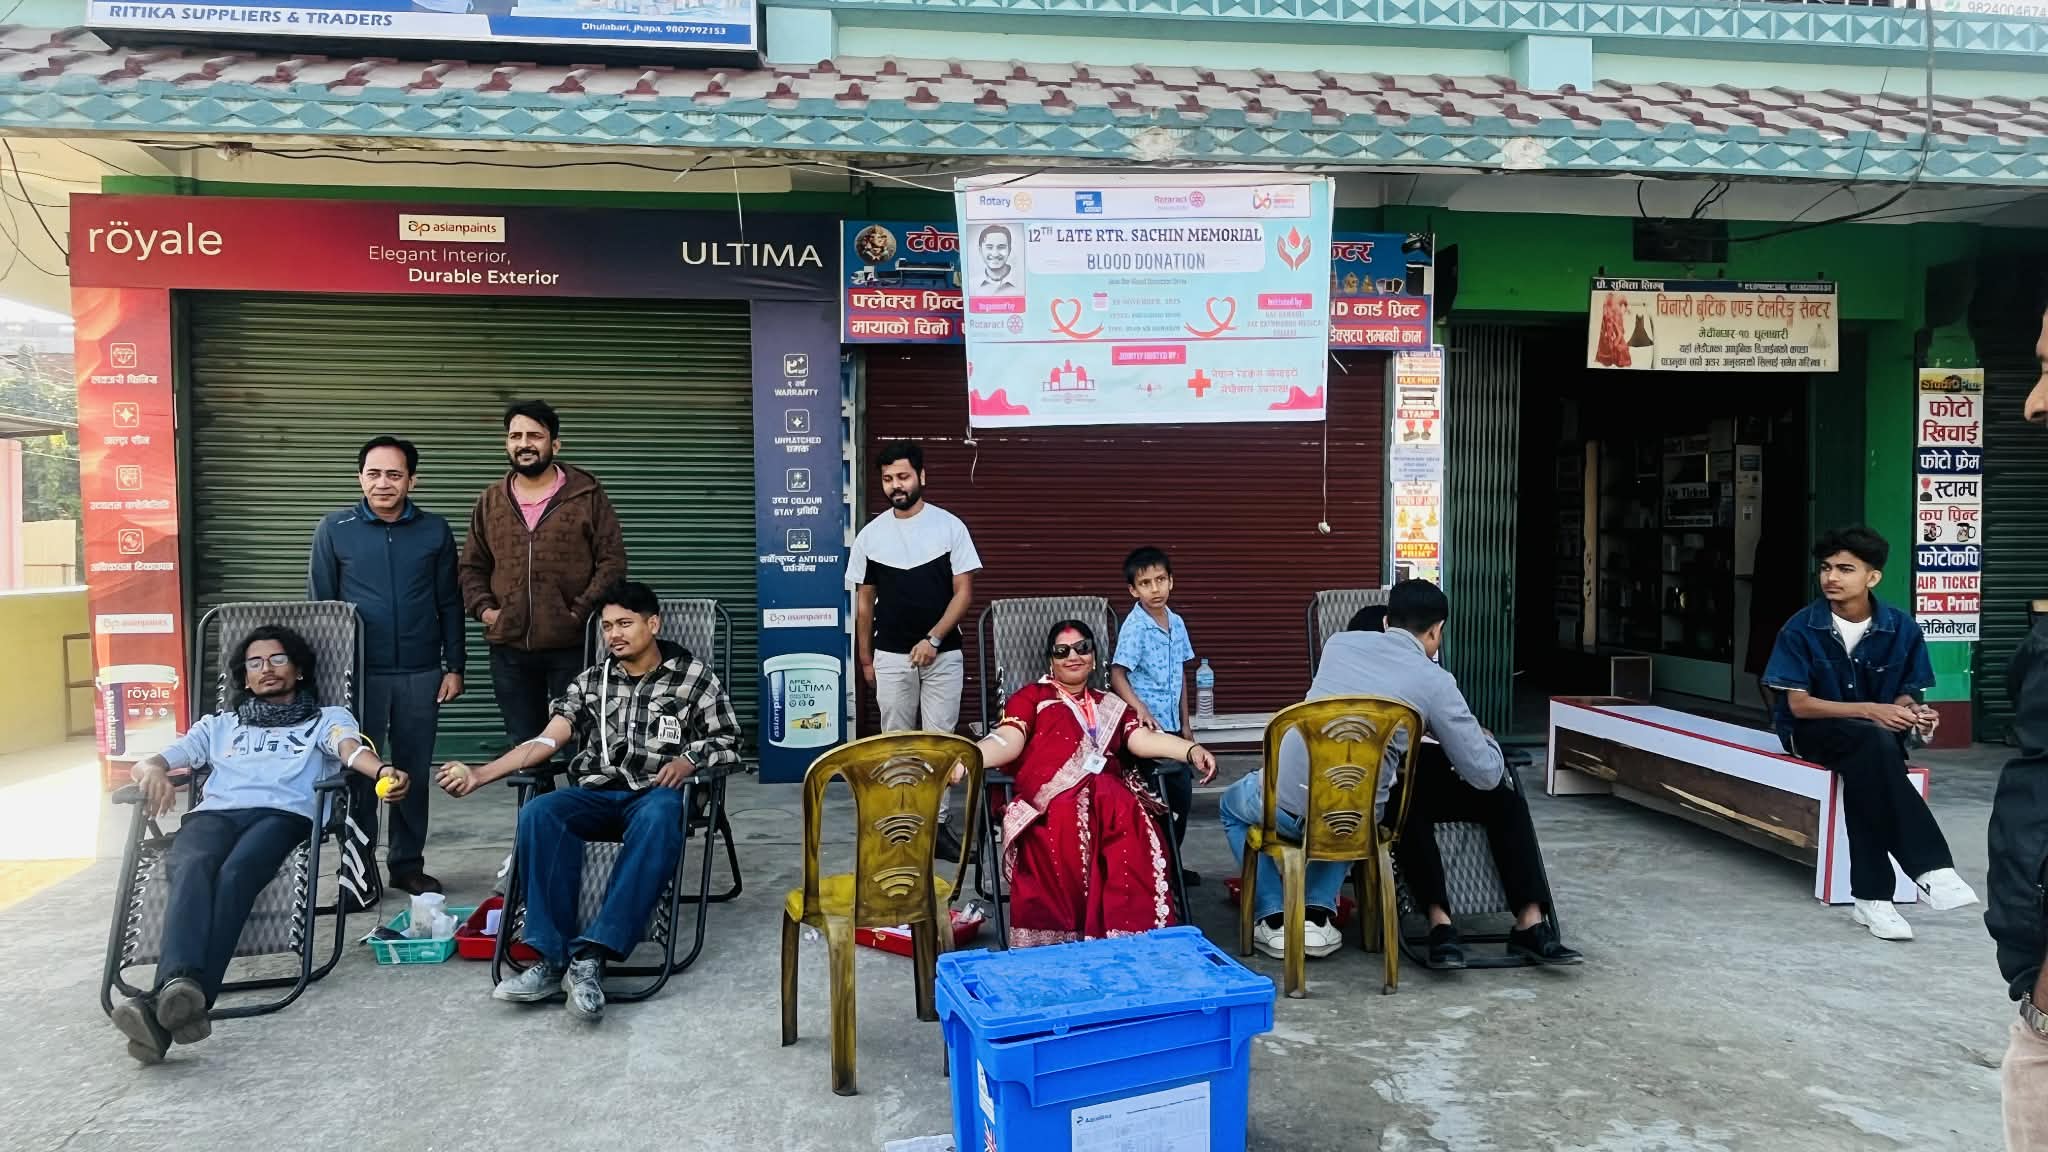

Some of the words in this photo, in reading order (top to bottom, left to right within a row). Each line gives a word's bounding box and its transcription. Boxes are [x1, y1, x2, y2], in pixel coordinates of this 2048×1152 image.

[109, 5, 176, 19] RITIKA
[181, 7, 281, 23] SUPPLIERS
[287, 12, 300, 23] &
[308, 12, 393, 26] TRADERS
[979, 195, 1011, 208] Rotary
[433, 222, 497, 236] asianpaints
[1028, 226, 1053, 243] 12TH
[1056, 228, 1093, 243] LATE
[1095, 229, 1128, 242] RTR.
[1131, 228, 1184, 242] SACHIN
[1187, 228, 1262, 242] MEMORIAL
[369, 246, 437, 264] Elegant
[443, 248, 511, 265] Interior,
[682, 241, 823, 268] ULTIMA
[1087, 253, 1132, 270] BLOOD
[1135, 252, 1206, 270] DONATION
[409, 268, 481, 284] Durable
[488, 270, 560, 285] Exterior
[851, 290, 916, 311] फ्लेक्स
[1696, 293, 1727, 321] बुटिक
[1799, 296, 1832, 319] सेन्टर
[1353, 300, 1384, 317] कार्ड
[1388, 300, 1421, 319] प्रिन्ट
[852, 317, 909, 336] मायाको
[913, 318, 950, 337] चिनो
[1402, 330, 1422, 344] काम
[774, 388, 818, 396] WARRANTY
[1929, 396, 1974, 418] फोटो
[1922, 420, 1979, 444] खिचाई
[1920, 449, 1953, 469] फोटो
[1955, 449, 1980, 471] फ्रेम
[1934, 481, 1979, 498] स्टाम्प
[791, 496, 822, 504] COLOUR
[774, 508, 794, 516] STAY
[1917, 546, 1980, 567] फोटोकपि
[1917, 576, 1937, 589] AIR
[1942, 575, 1979, 589] TICKET
[1916, 596, 1943, 612] Flex
[1947, 596, 1979, 611] Print
[788, 683, 833, 693] ULTIMA
